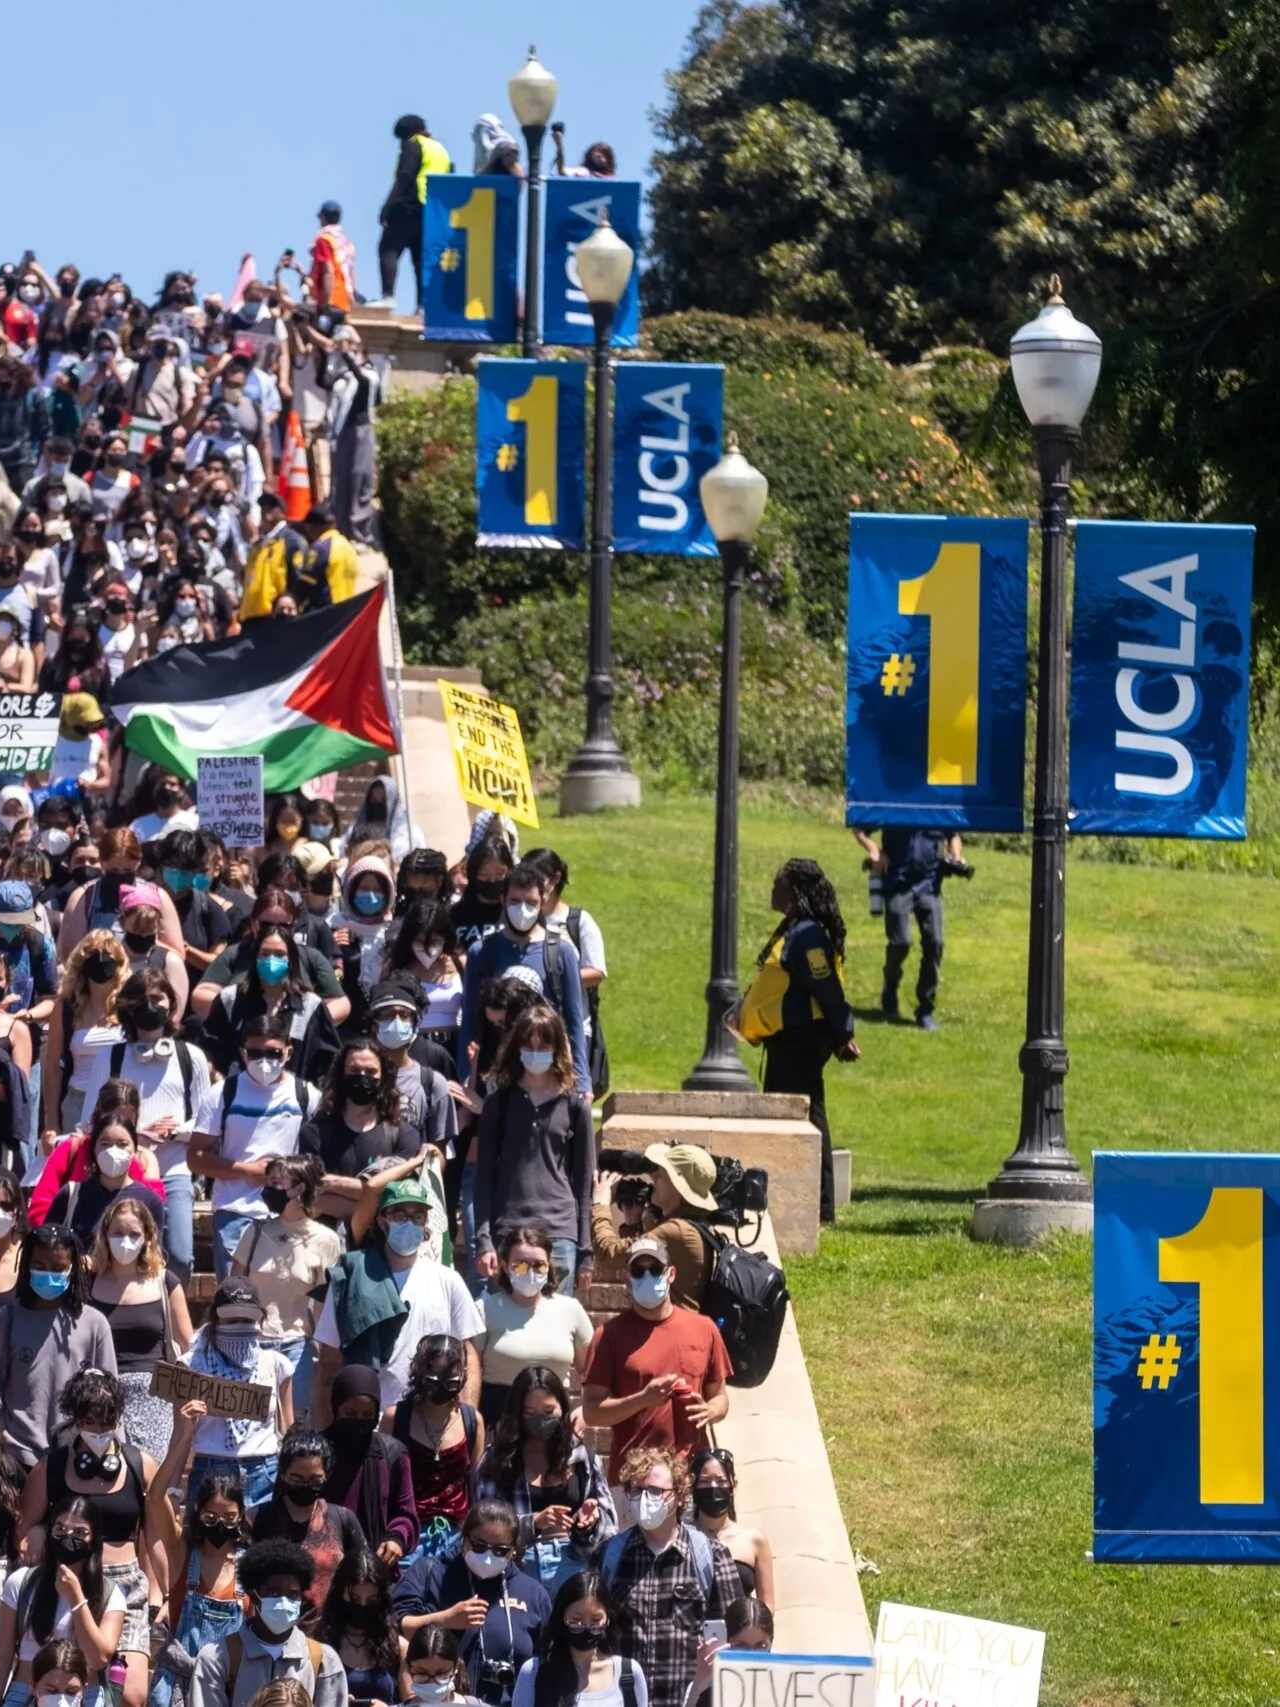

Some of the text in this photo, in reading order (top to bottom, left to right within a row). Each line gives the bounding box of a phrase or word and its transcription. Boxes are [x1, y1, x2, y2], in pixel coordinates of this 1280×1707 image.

[439, 187, 497, 321] #1
[496, 375, 559, 526] #1
[637, 381, 692, 532] UCLA
[879, 542, 982, 786] #1
[1114, 552, 1200, 797] UCLA
[34, 691, 57, 720] $
[197, 756, 260, 768] PALESTINE
[457, 721, 519, 760] END THE
[215, 792, 258, 807] struggle
[232, 777, 253, 789] test
[468, 759, 529, 813] NOW!
[218, 807, 262, 821] injustice
[1136, 1187, 1264, 1505] #1
[155, 1364, 272, 1419] FREE PALESTINE
[880, 1612, 1035, 1668] LAND YOU
[718, 1667, 866, 1707] DIVEST
[876, 1654, 1021, 1707] HAVE TO
